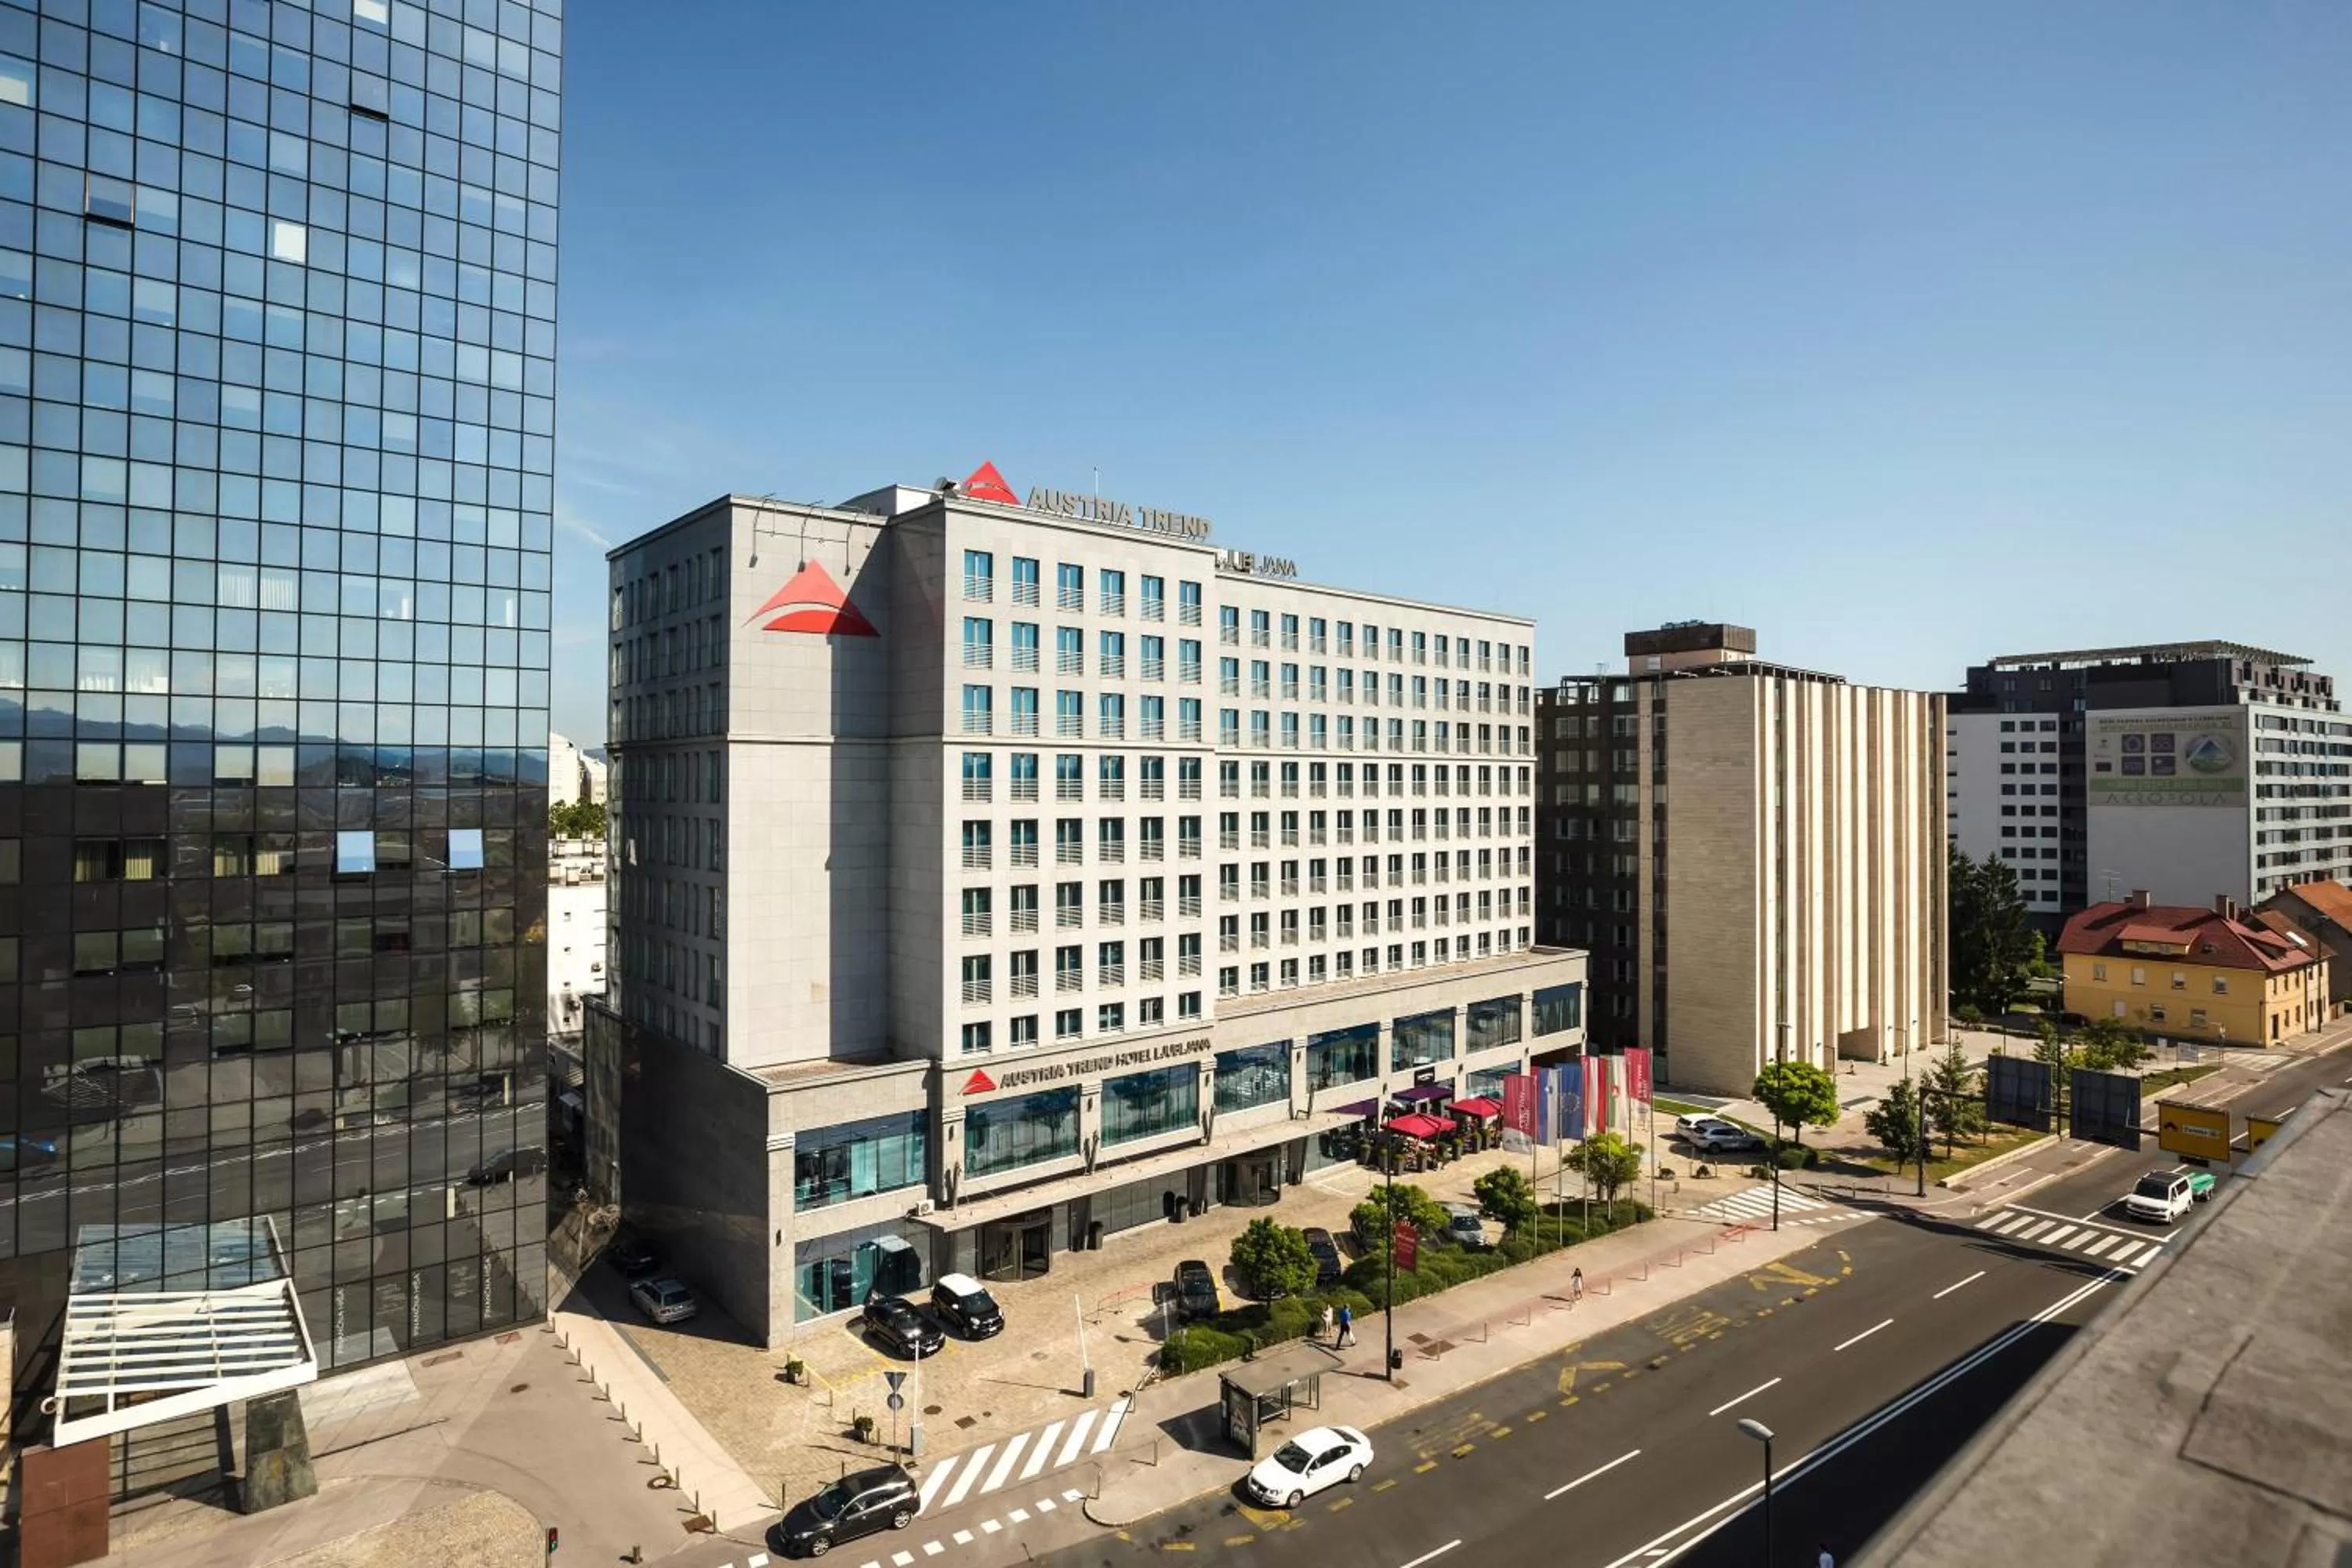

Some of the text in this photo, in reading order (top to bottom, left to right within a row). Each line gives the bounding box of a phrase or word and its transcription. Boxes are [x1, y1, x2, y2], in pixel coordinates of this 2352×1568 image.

[1026, 486, 1213, 538] AUSTRIA TREND
[1000, 1038, 1211, 1088] AUSTRIA TREND HOTEL LJUBLJANA
